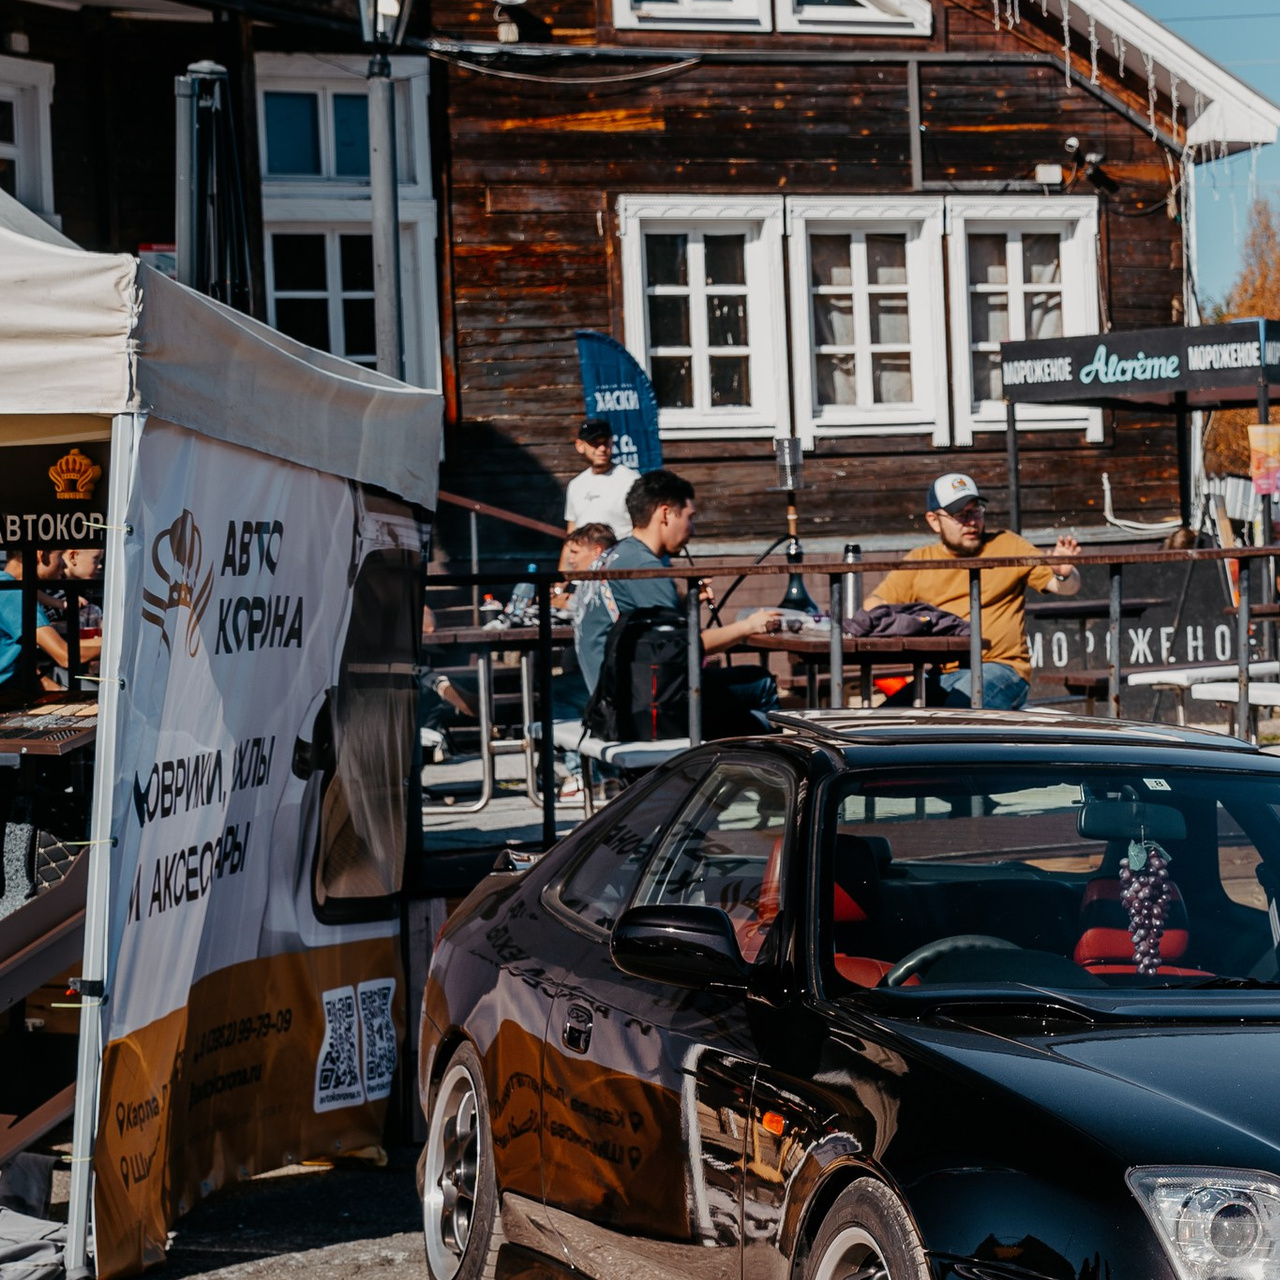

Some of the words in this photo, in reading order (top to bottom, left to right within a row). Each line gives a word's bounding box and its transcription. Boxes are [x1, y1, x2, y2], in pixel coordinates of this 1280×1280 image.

[1003, 357, 1073, 386] МОРОЖЕНОЕ
[1188, 341, 1261, 371] МОРОЖЕНОЕ
[0, 511, 104, 544] ВТОКОР
